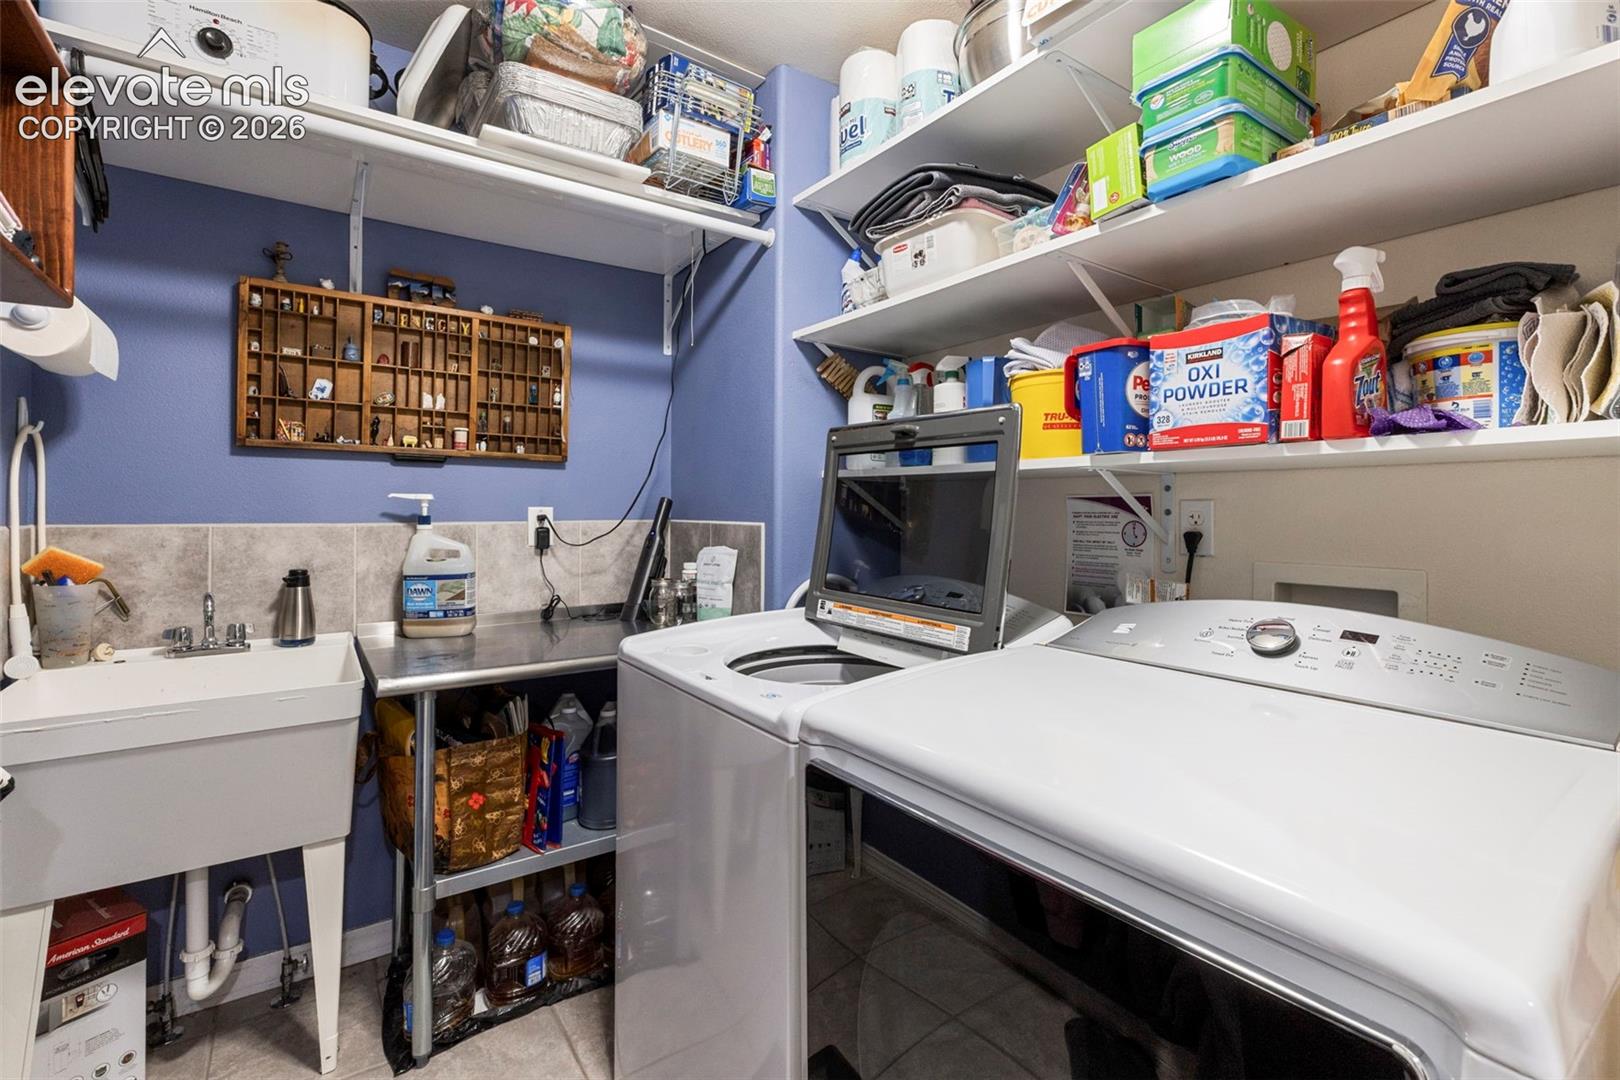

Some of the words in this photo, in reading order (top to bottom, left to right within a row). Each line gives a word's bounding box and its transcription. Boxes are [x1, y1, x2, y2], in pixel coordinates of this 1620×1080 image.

[189, 4, 220, 18] Hamilton
[220, 14, 243, 25] Beach
[1169, 144, 1202, 163] WOOD
[1187, 348, 1222, 360] KIRKLAND
[1188, 363, 1220, 382] OXI
[1133, 375, 1150, 391] Pe
[1163, 378, 1248, 403] POWDER
[1354, 370, 1380, 407] Zout
[1156, 415, 1171, 424] 328
[407, 587, 432, 597] DAWN
[47, 943, 90, 966] American
[92, 926, 130, 949] Standard
